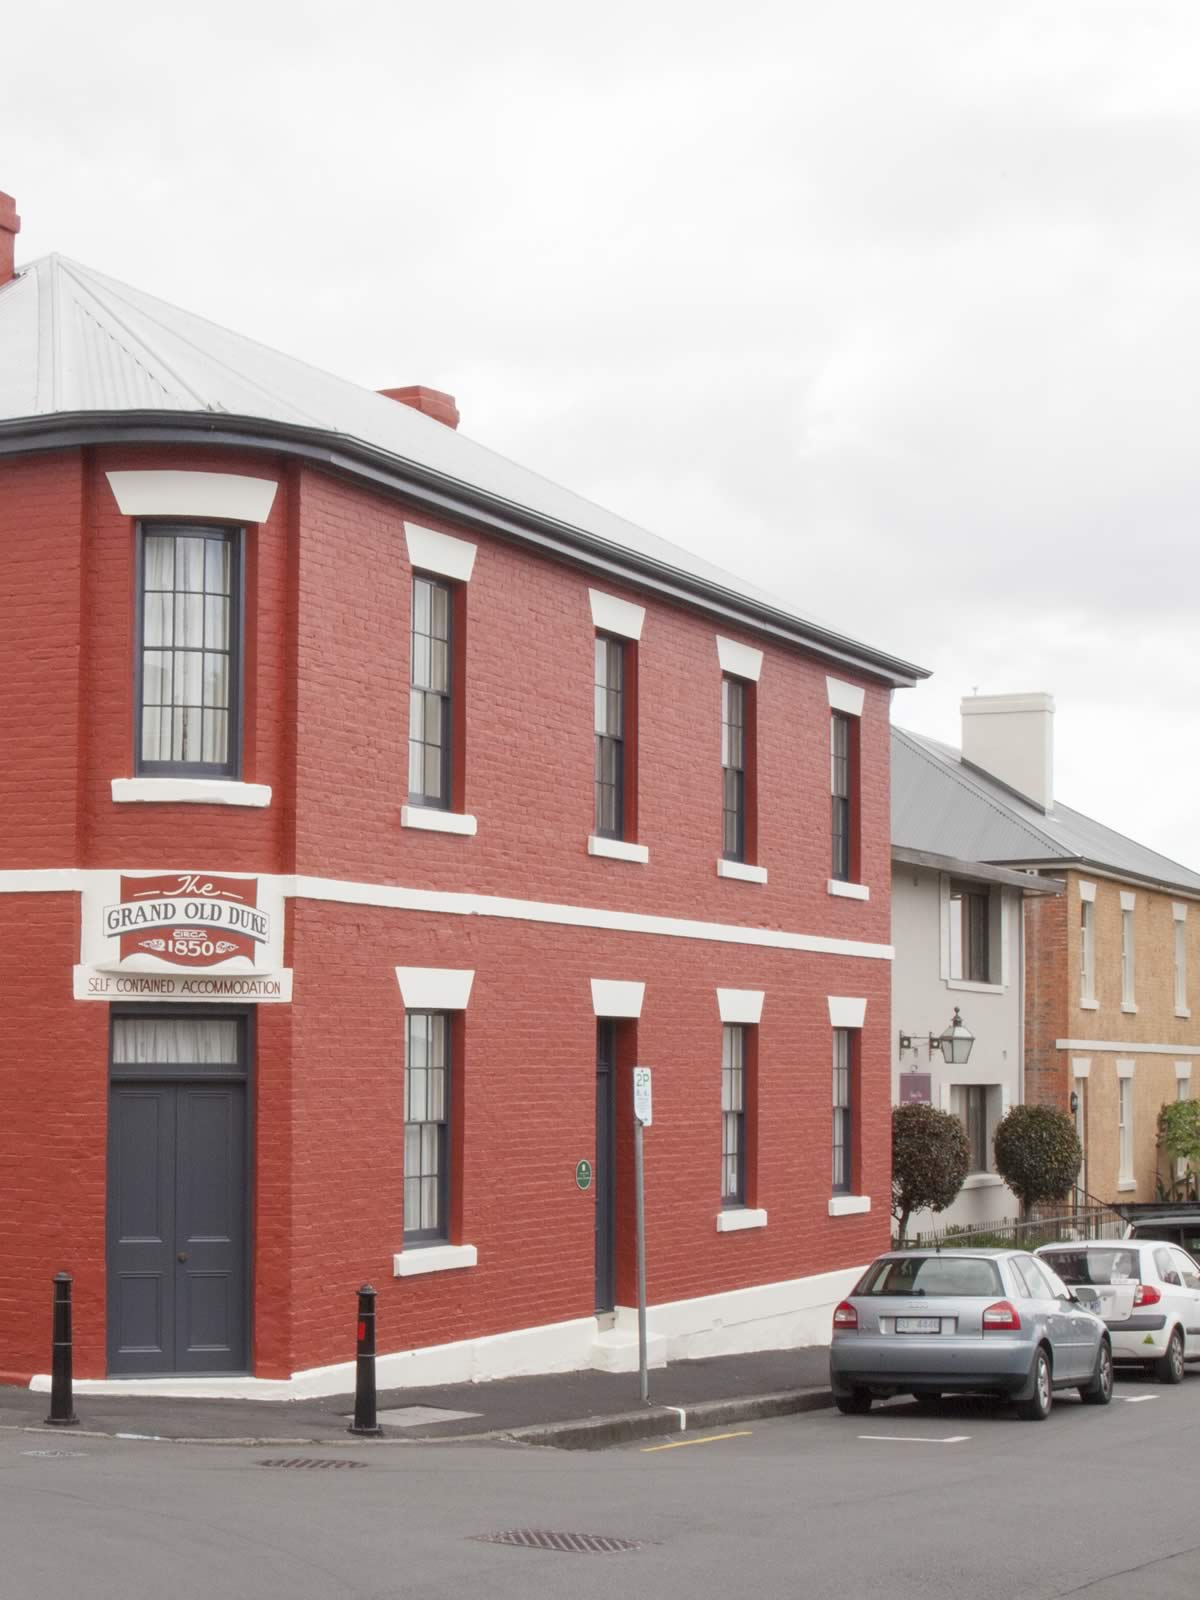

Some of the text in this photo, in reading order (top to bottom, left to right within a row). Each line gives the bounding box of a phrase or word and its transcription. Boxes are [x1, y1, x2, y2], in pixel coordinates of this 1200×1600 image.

[163, 875, 221, 896] The
[107, 902, 268, 935] GRAND OLD DUKE
[167, 940, 215, 957] 1850
[88, 977, 281, 995] SELF CONTAINED ACCOMMODATION
[636, 1073, 650, 1088] 2P
